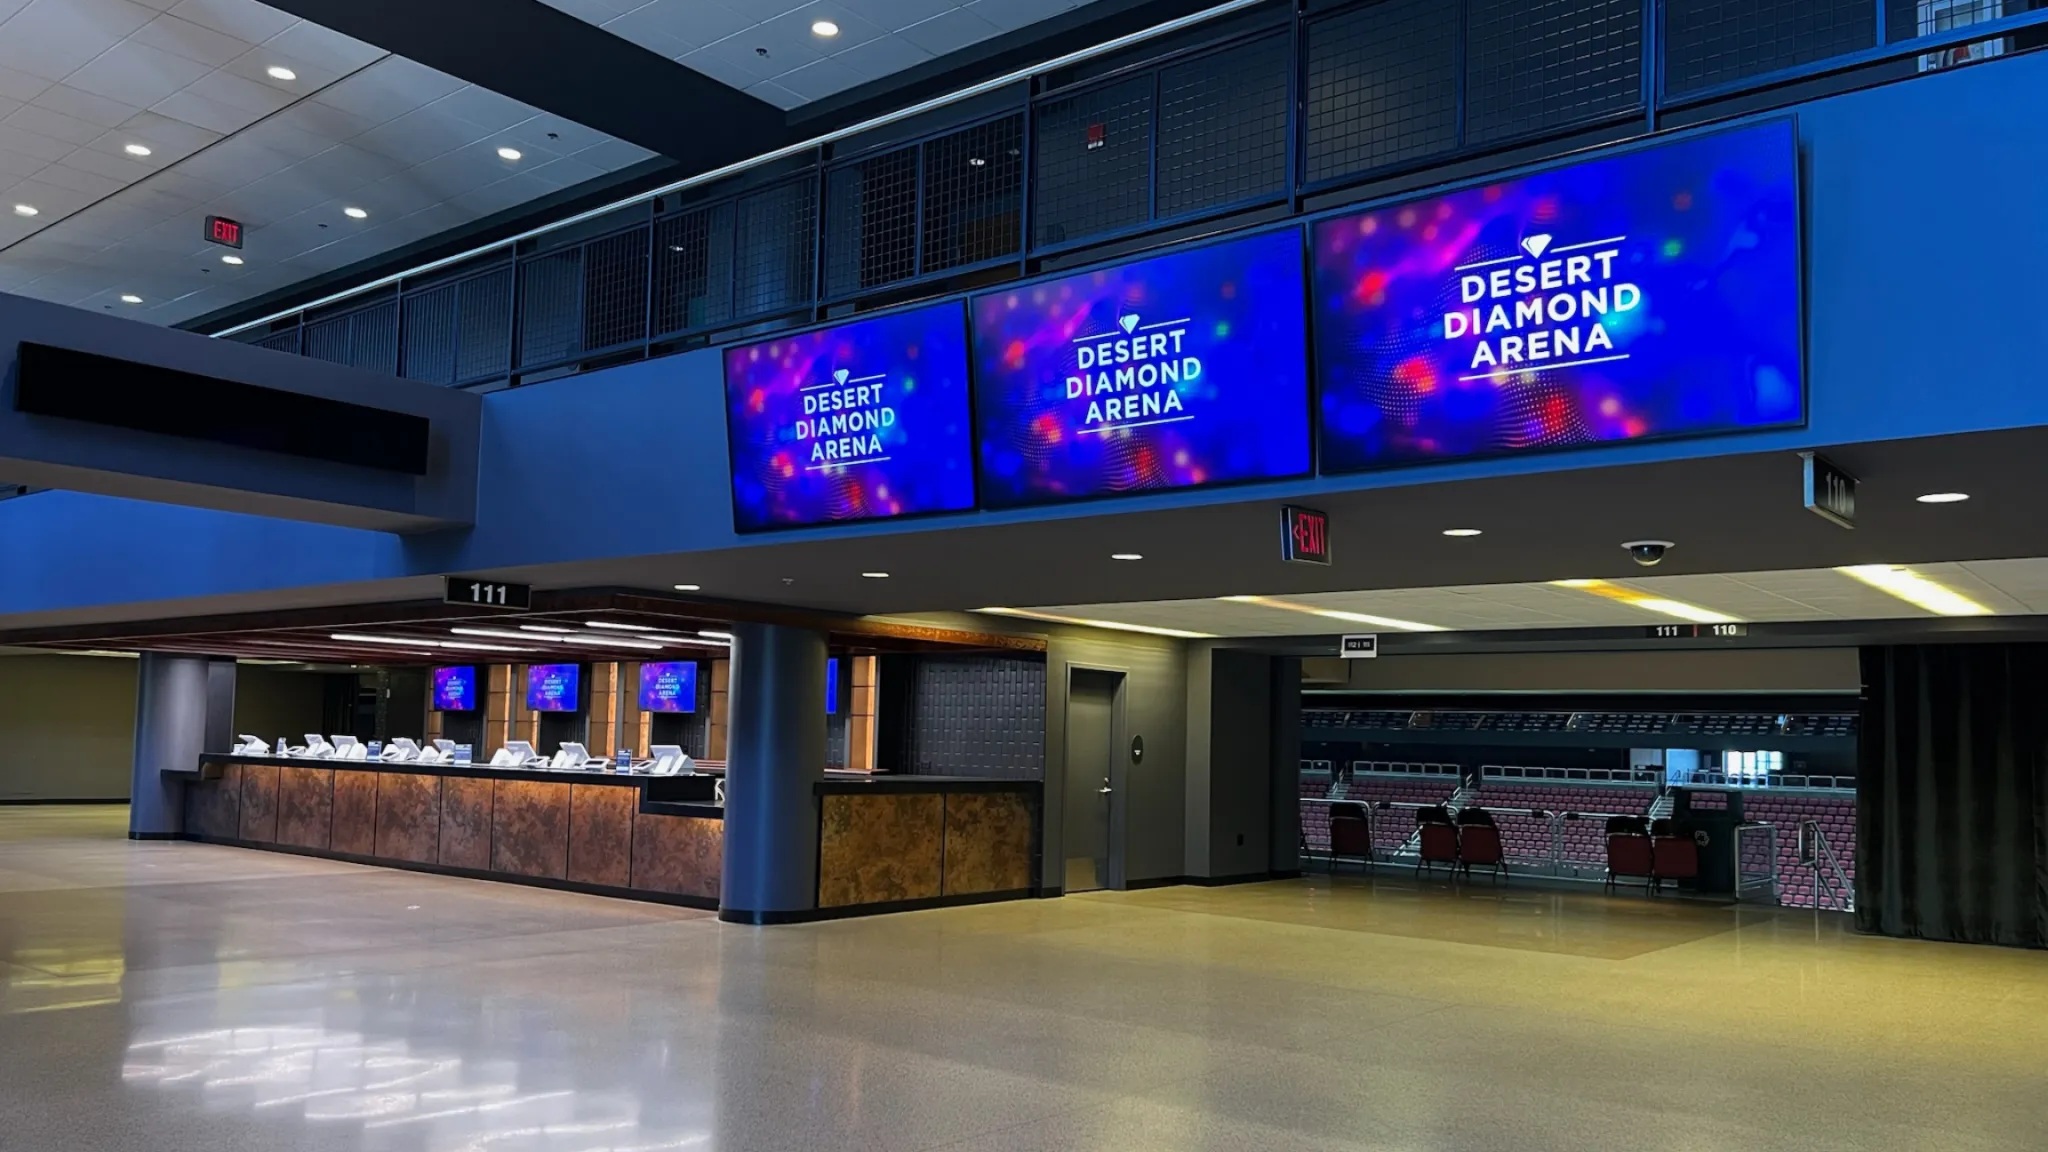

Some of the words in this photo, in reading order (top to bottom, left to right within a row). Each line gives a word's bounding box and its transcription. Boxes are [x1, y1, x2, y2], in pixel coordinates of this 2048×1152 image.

[214, 220, 239, 243] EXIT
[1461, 249, 1619, 303] DESERT
[1444, 283, 1641, 339] DIAMOND
[1077, 329, 1186, 369] DESERT
[1471, 322, 1613, 369] ARENA
[1066, 357, 1202, 399] DIAMOND
[803, 383, 883, 415] DESERT
[1085, 389, 1184, 424] ARENA
[795, 407, 895, 440] DIAMOND
[811, 434, 883, 462] ARENA
[1826, 471, 1847, 514] 110
[1298, 513, 1325, 556] EXIT
[470, 582, 507, 605] 111
[1656, 625, 1679, 637] 111
[1712, 624, 1737, 636] 110
